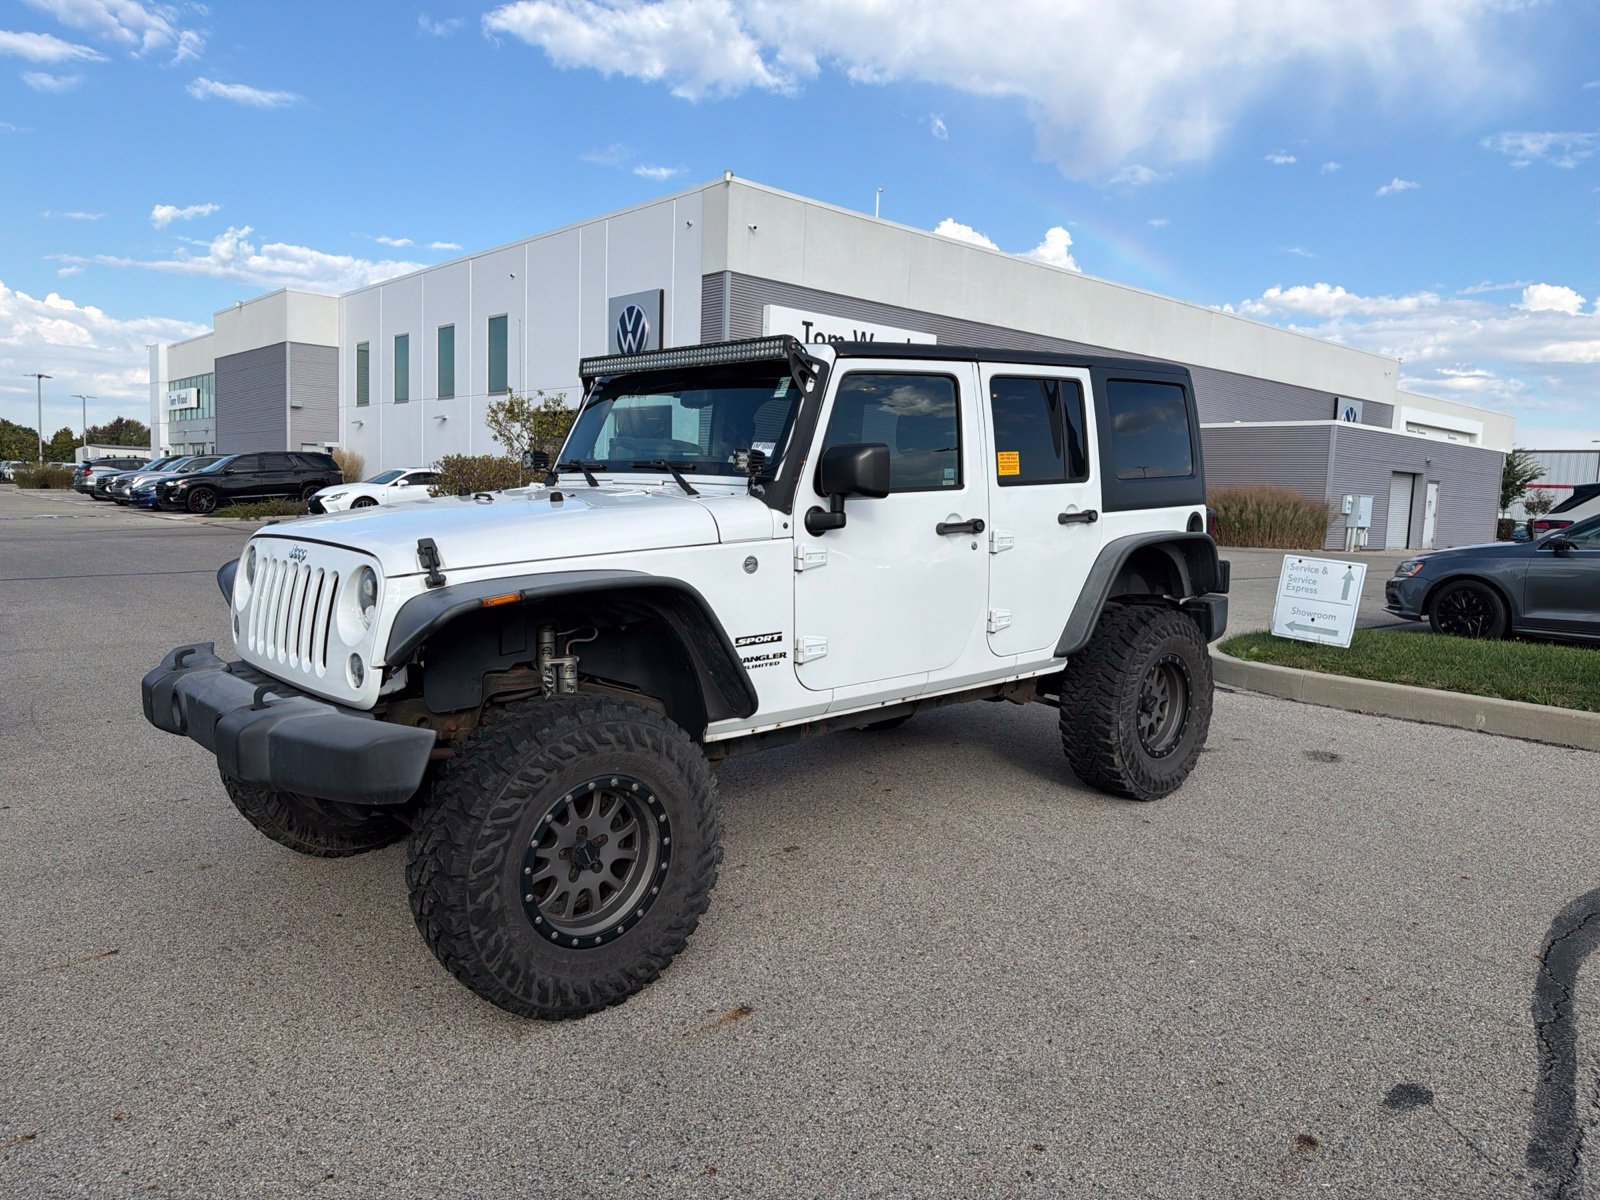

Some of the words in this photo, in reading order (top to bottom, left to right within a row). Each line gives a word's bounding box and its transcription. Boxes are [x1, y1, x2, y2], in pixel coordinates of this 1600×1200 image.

[289, 544, 307, 563] Jeep
[1290, 563, 1319, 574] Service
[1321, 566, 1328, 575] &
[1287, 574, 1317, 585] Service
[1286, 583, 1318, 594] Express
[1291, 606, 1337, 621] Showroom
[736, 633, 782, 646] SPORT
[740, 652, 787, 663] ANGLER
[744, 661, 780, 670] LIMITED
